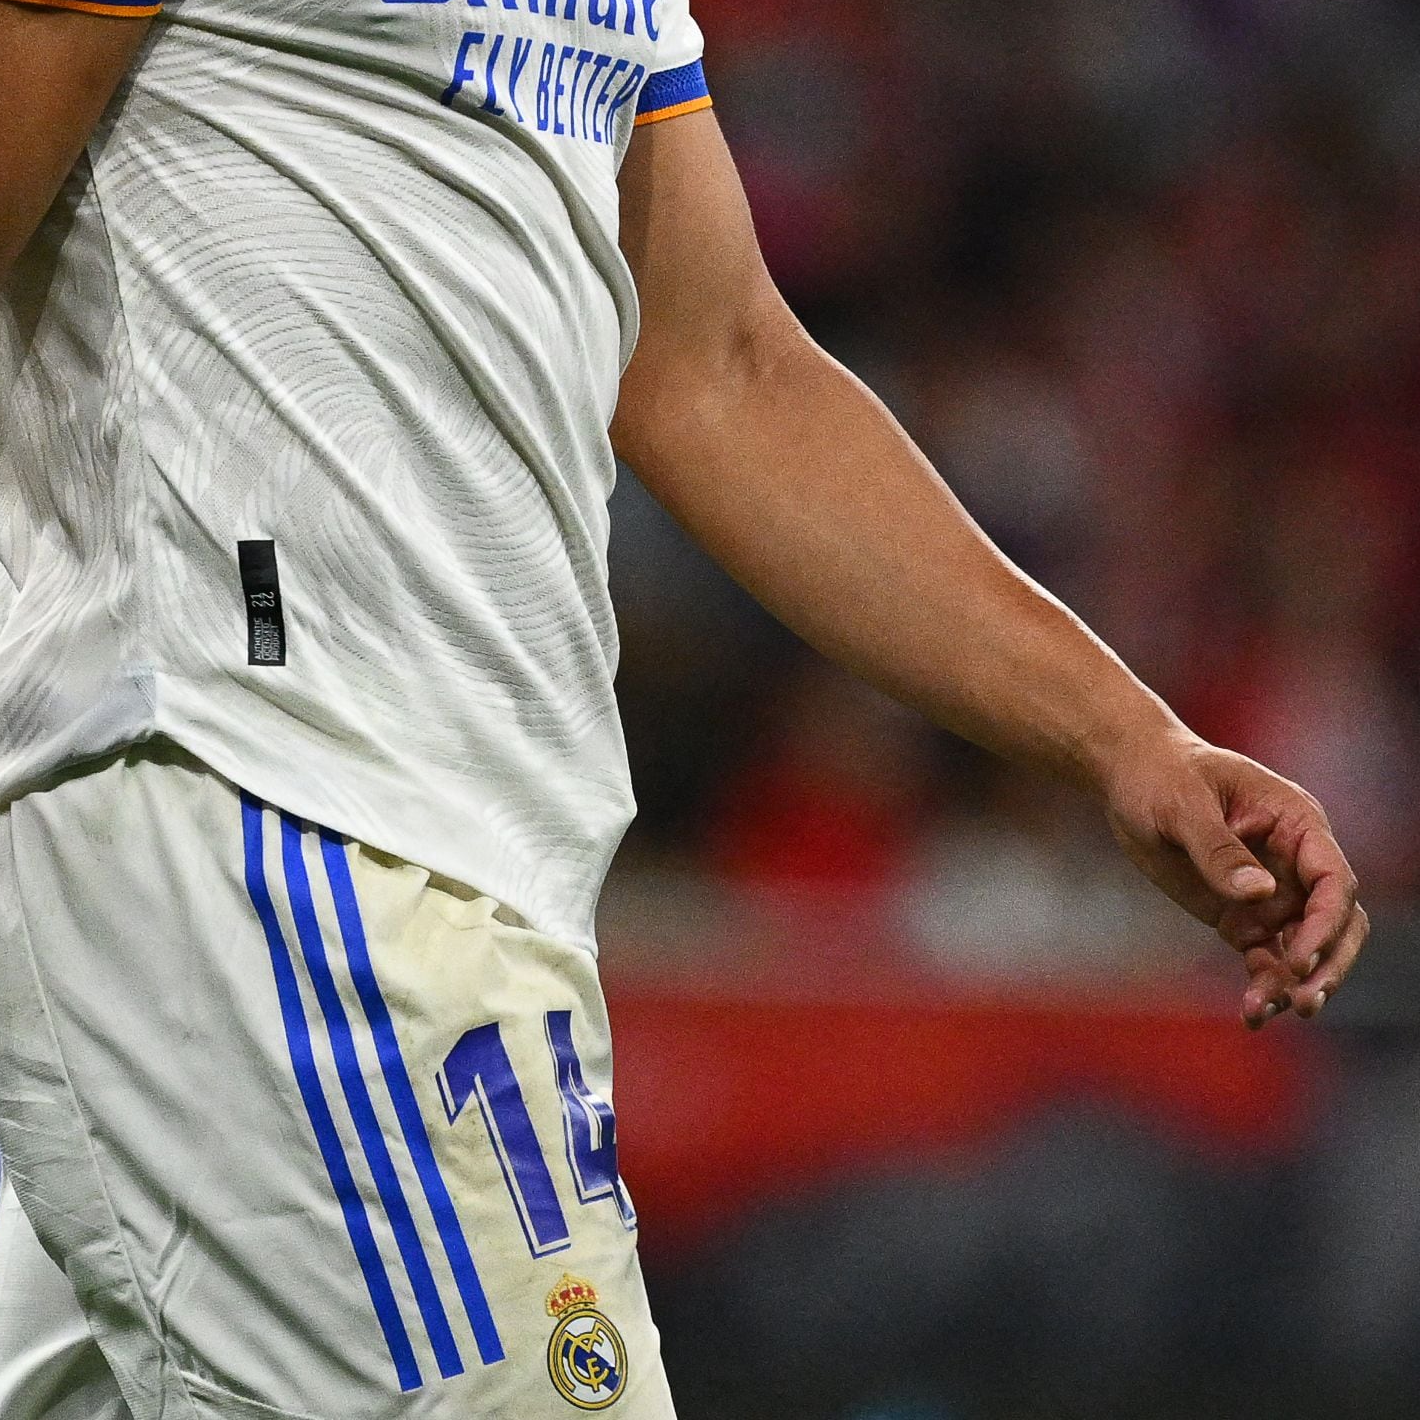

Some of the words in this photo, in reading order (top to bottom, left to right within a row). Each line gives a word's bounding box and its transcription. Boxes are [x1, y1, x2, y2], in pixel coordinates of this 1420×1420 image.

[441, 32, 532, 123] FLY
[537, 43, 646, 146] BETTER
[435, 1010, 638, 1260] 14
